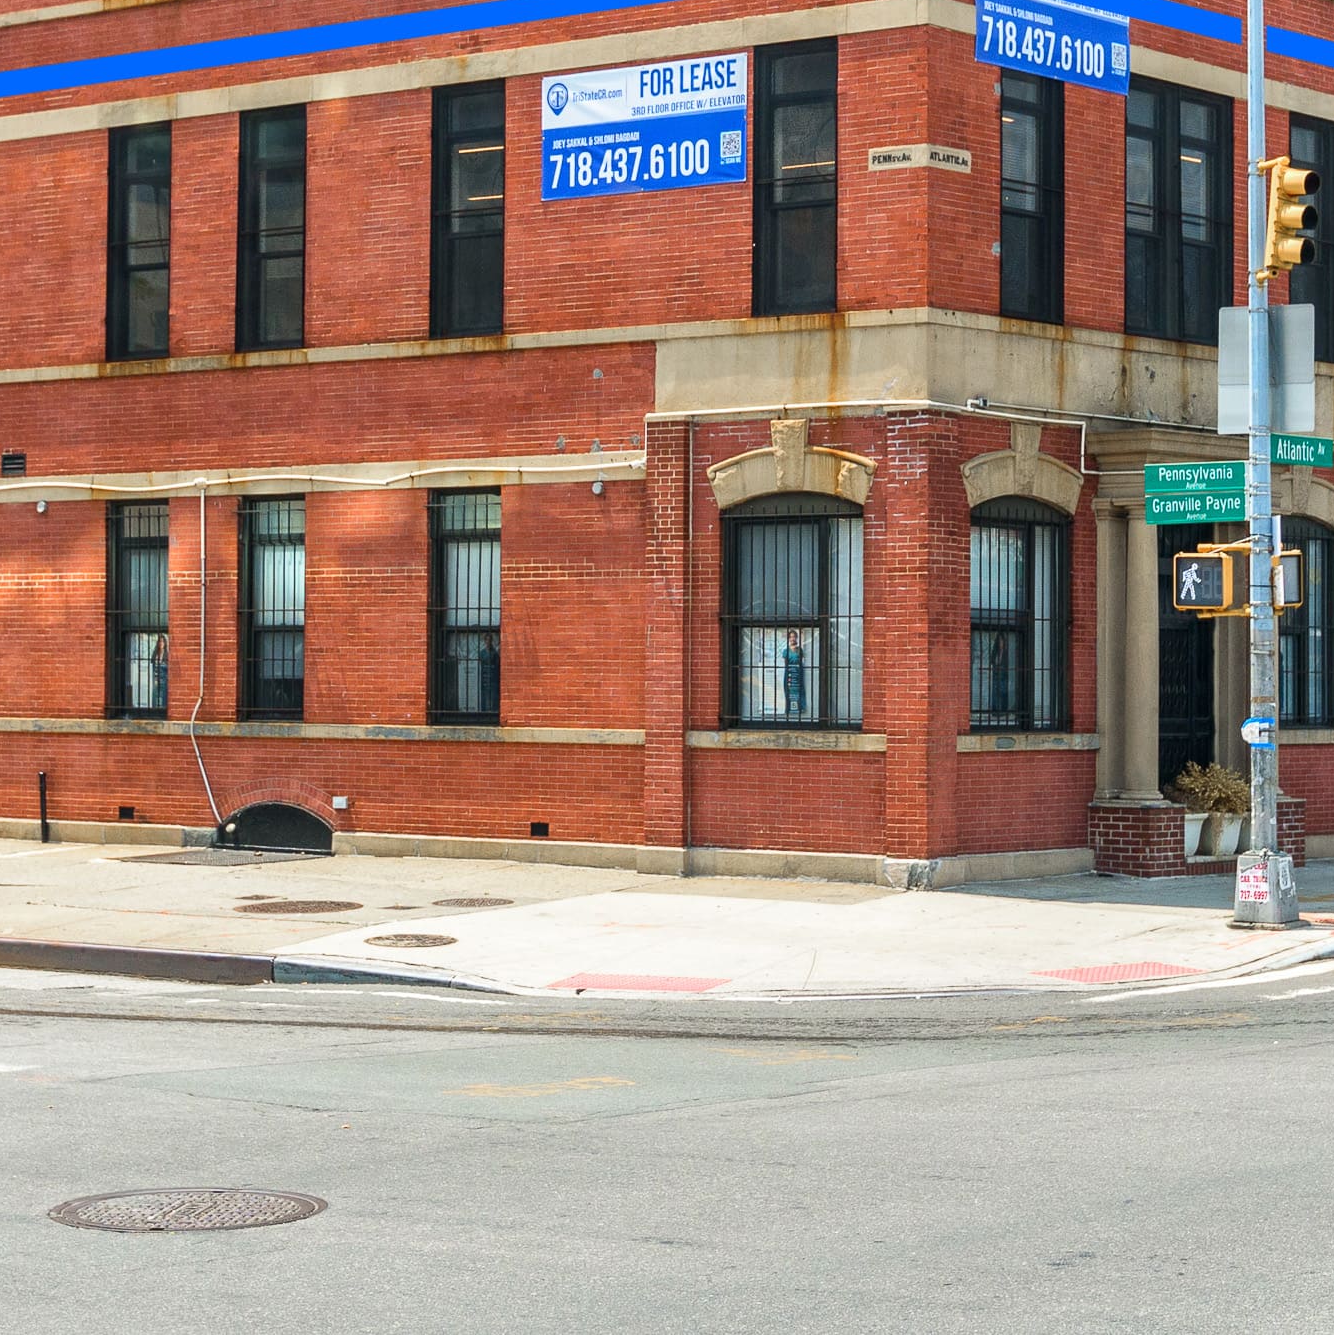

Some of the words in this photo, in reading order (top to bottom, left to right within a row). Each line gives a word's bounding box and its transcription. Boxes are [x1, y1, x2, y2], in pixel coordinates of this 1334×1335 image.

[981, 15, 1105, 79] 718.437.6100
[640, 67, 674, 98] FOR
[680, 59, 737, 93] LEASE
[572, 89, 623, 103] TriStateCR.com
[631, 107, 646, 116] 3RD
[647, 103, 669, 114] FLOOR
[671, 101, 694, 112] OFFICE
[697, 98, 707, 109] W/
[709, 94, 746, 107] ELEVATOR
[553, 139, 566, 150] JOEY
[588, 136, 593, 146] &
[549, 139, 710, 190] 718.437.6100
[1277, 438, 1315, 462] Atlantic
[1318, 443, 1325, 455] Av
[1158, 465, 1233, 483] Pennsylvania
[1185, 482, 1206, 490] Avenue
[1152, 497, 1201, 514] Granville
[1206, 495, 1241, 513] Payne
[1186, 512, 1207, 521] Avenue
